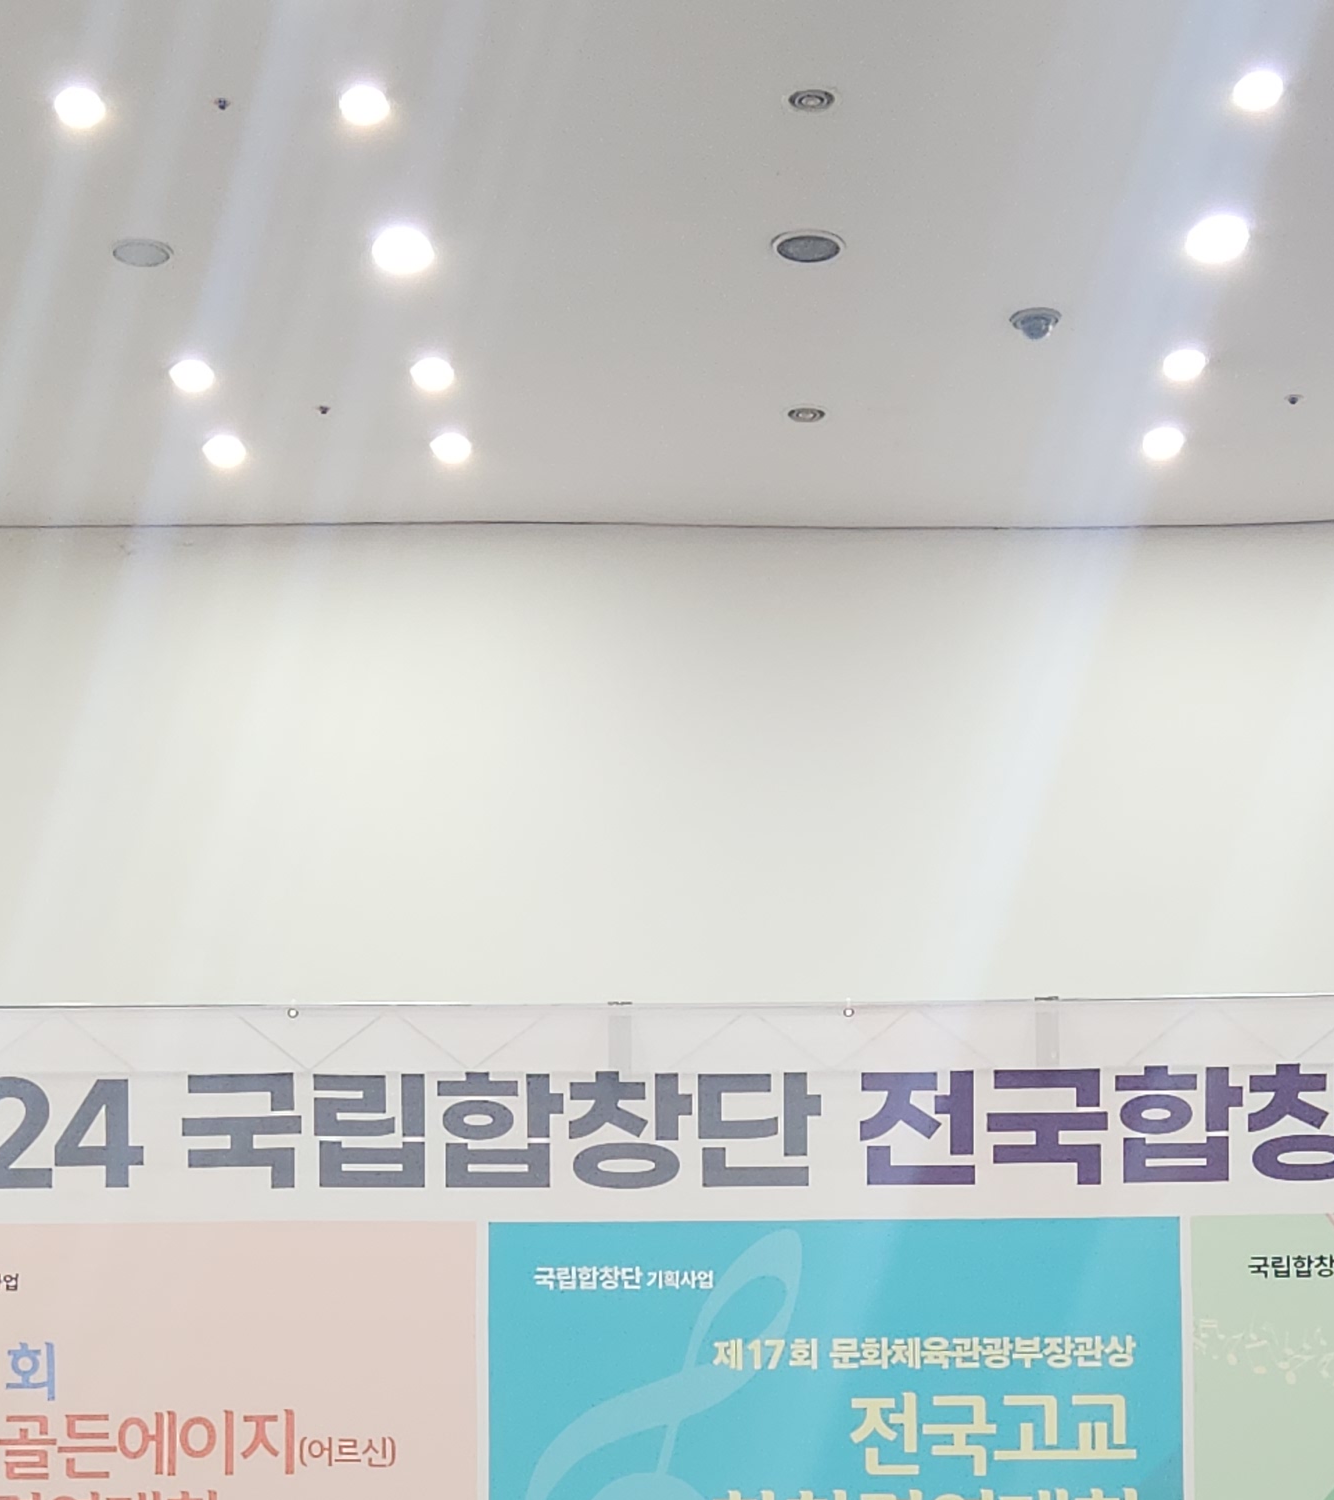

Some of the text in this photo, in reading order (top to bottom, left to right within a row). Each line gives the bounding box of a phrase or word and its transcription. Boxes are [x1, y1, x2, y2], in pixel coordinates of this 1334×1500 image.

[182, 1070, 821, 1190] 국립합창단
[534, 1265, 714, 1290] 국립합창단 기획사업
[713, 1334, 1137, 1371] 제17회 문화체육관광부장관상
[850, 1391, 1138, 1477] 전국고교
